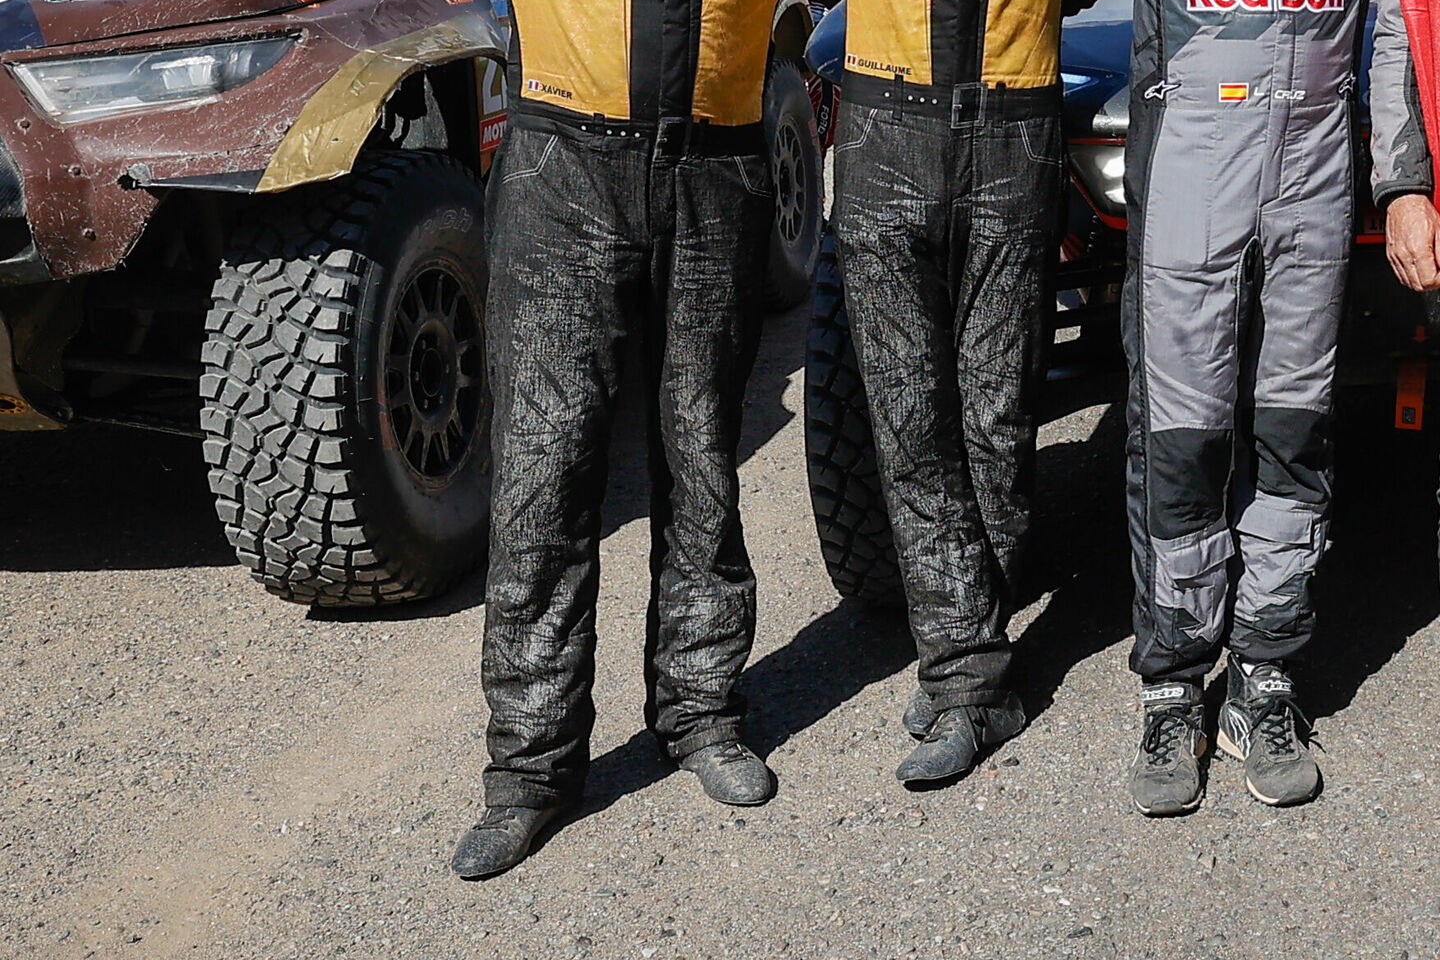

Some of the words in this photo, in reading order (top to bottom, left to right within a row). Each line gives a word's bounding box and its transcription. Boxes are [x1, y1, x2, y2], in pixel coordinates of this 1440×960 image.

[857, 58, 913, 76] GUILLAUME
[541, 83, 573, 100] XAVIER
[1274, 90, 1306, 100] CRUZ
[817, 104, 830, 135] FORD
[483, 121, 508, 147] MOT
